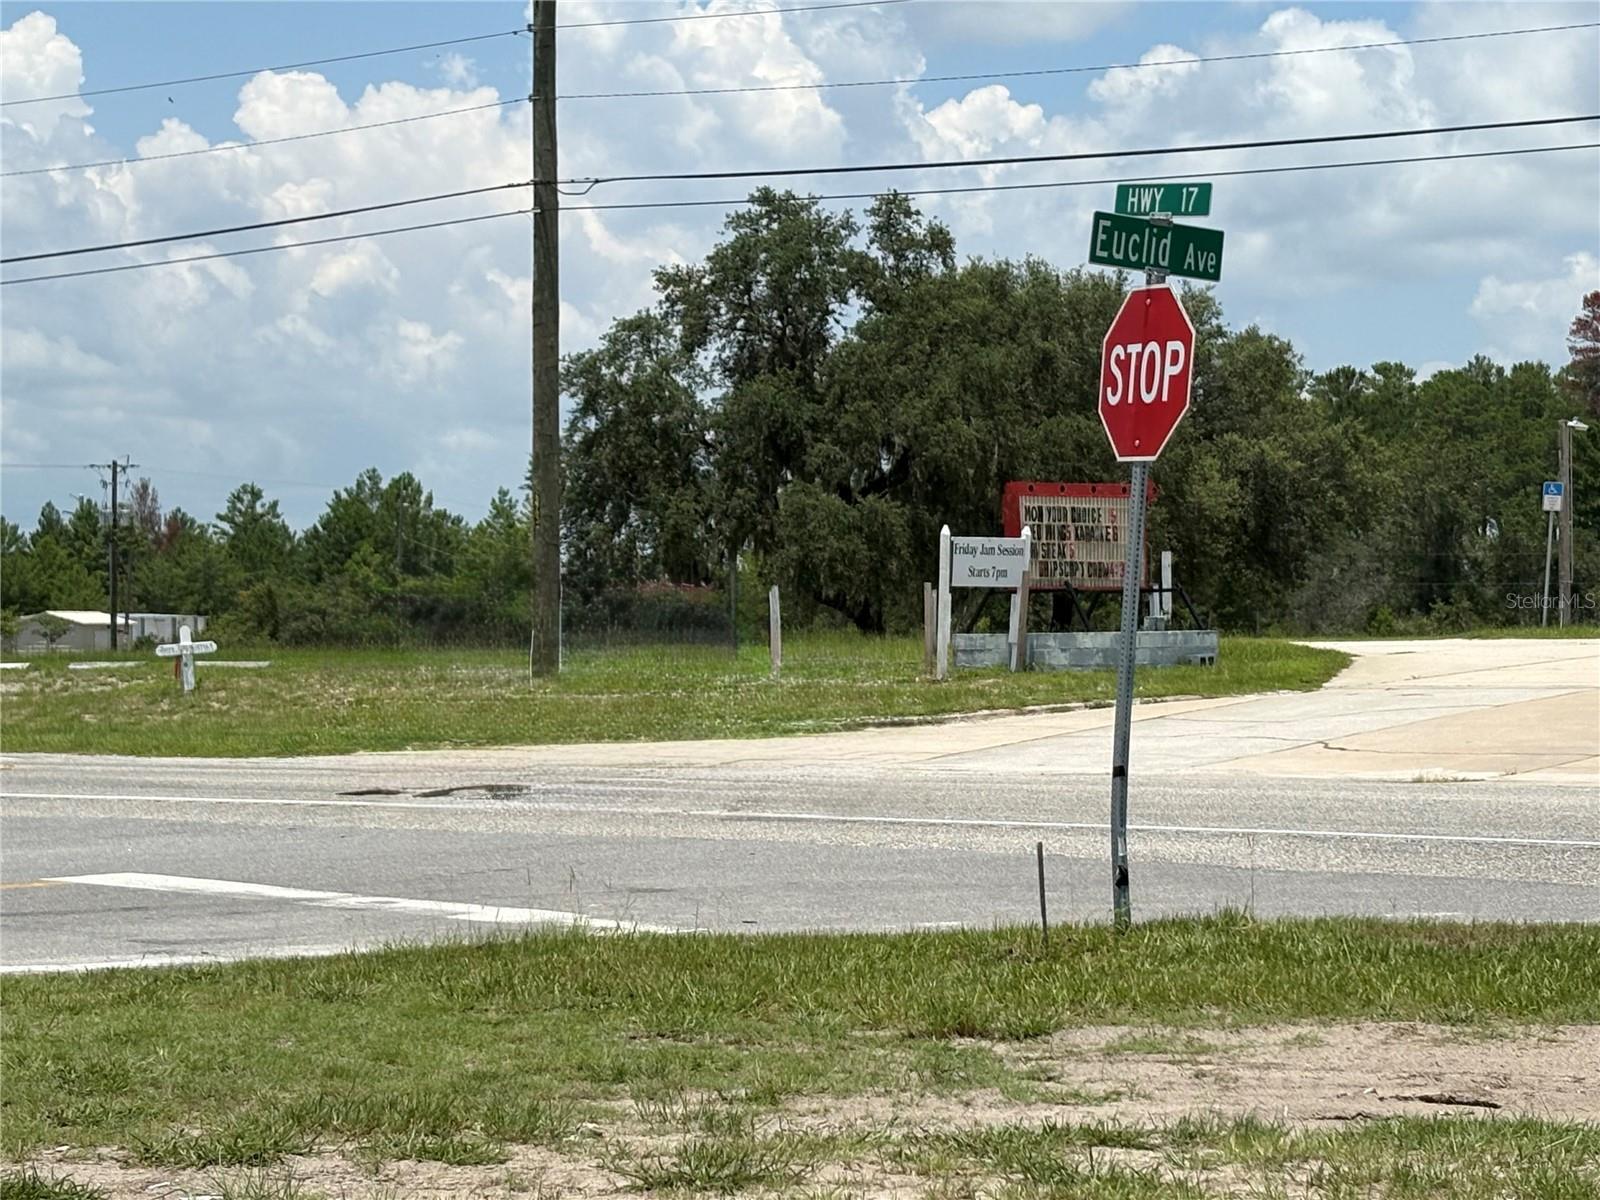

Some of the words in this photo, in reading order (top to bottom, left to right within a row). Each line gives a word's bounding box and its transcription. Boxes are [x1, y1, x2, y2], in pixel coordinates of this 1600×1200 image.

[1127, 186, 1165, 213] HWY
[1180, 186, 1199, 213] 17
[1095, 218, 1172, 267] Euclid
[1183, 242, 1217, 273] Ave
[1106, 340, 1186, 406] STOP
[954, 542, 979, 558] Friday
[979, 543, 996, 556] Jam
[996, 544, 1024, 557] Session
[1041, 542, 1067, 559] STEAK
[967, 565, 991, 578] Starts
[991, 566, 1008, 581] 7pm
